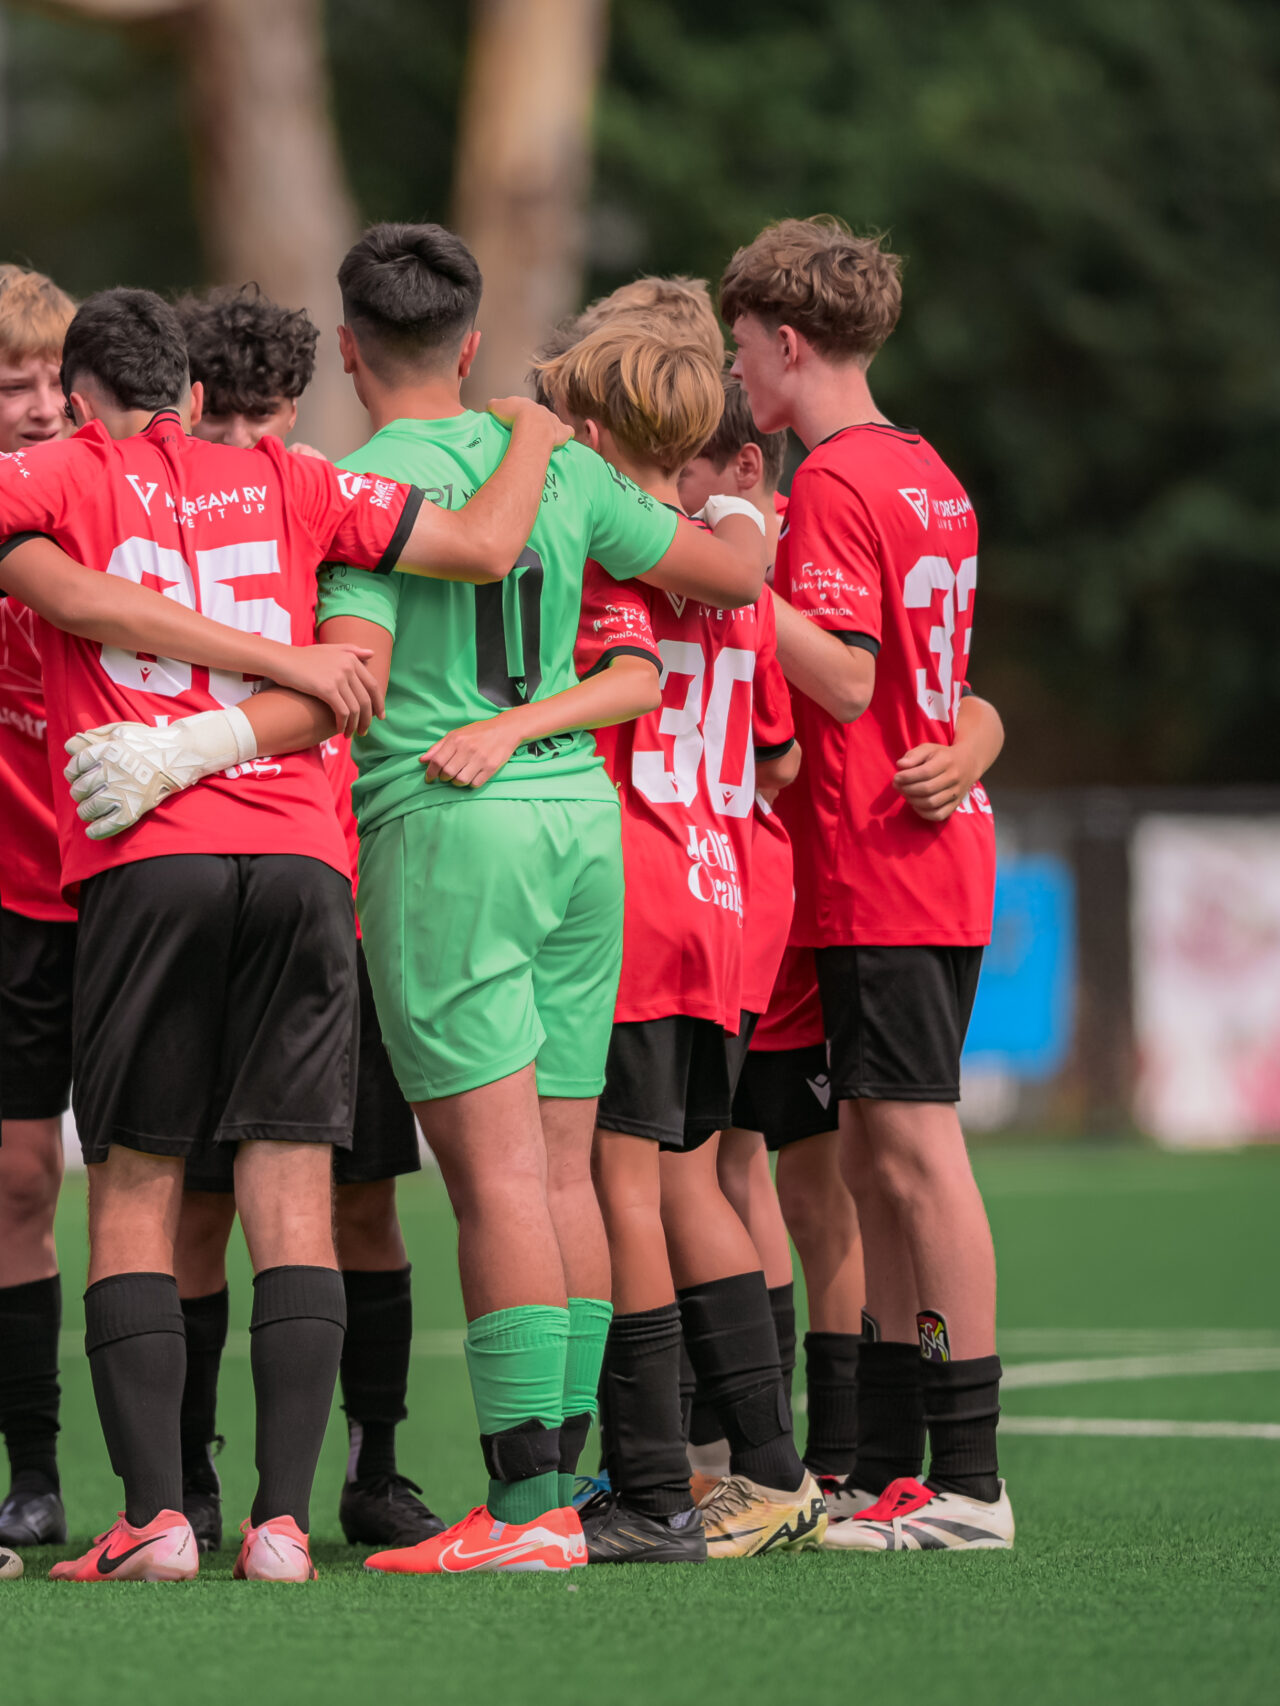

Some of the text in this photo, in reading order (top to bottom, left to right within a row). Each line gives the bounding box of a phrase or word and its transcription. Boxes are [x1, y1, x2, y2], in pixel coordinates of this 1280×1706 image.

[242, 485, 267, 502] RV
[208, 508, 226, 522] IT
[242, 503, 265, 514] UP
[800, 607, 853, 617] OUNDATION
[631, 638, 757, 819] 30
[686, 824, 737, 873] Jelli
